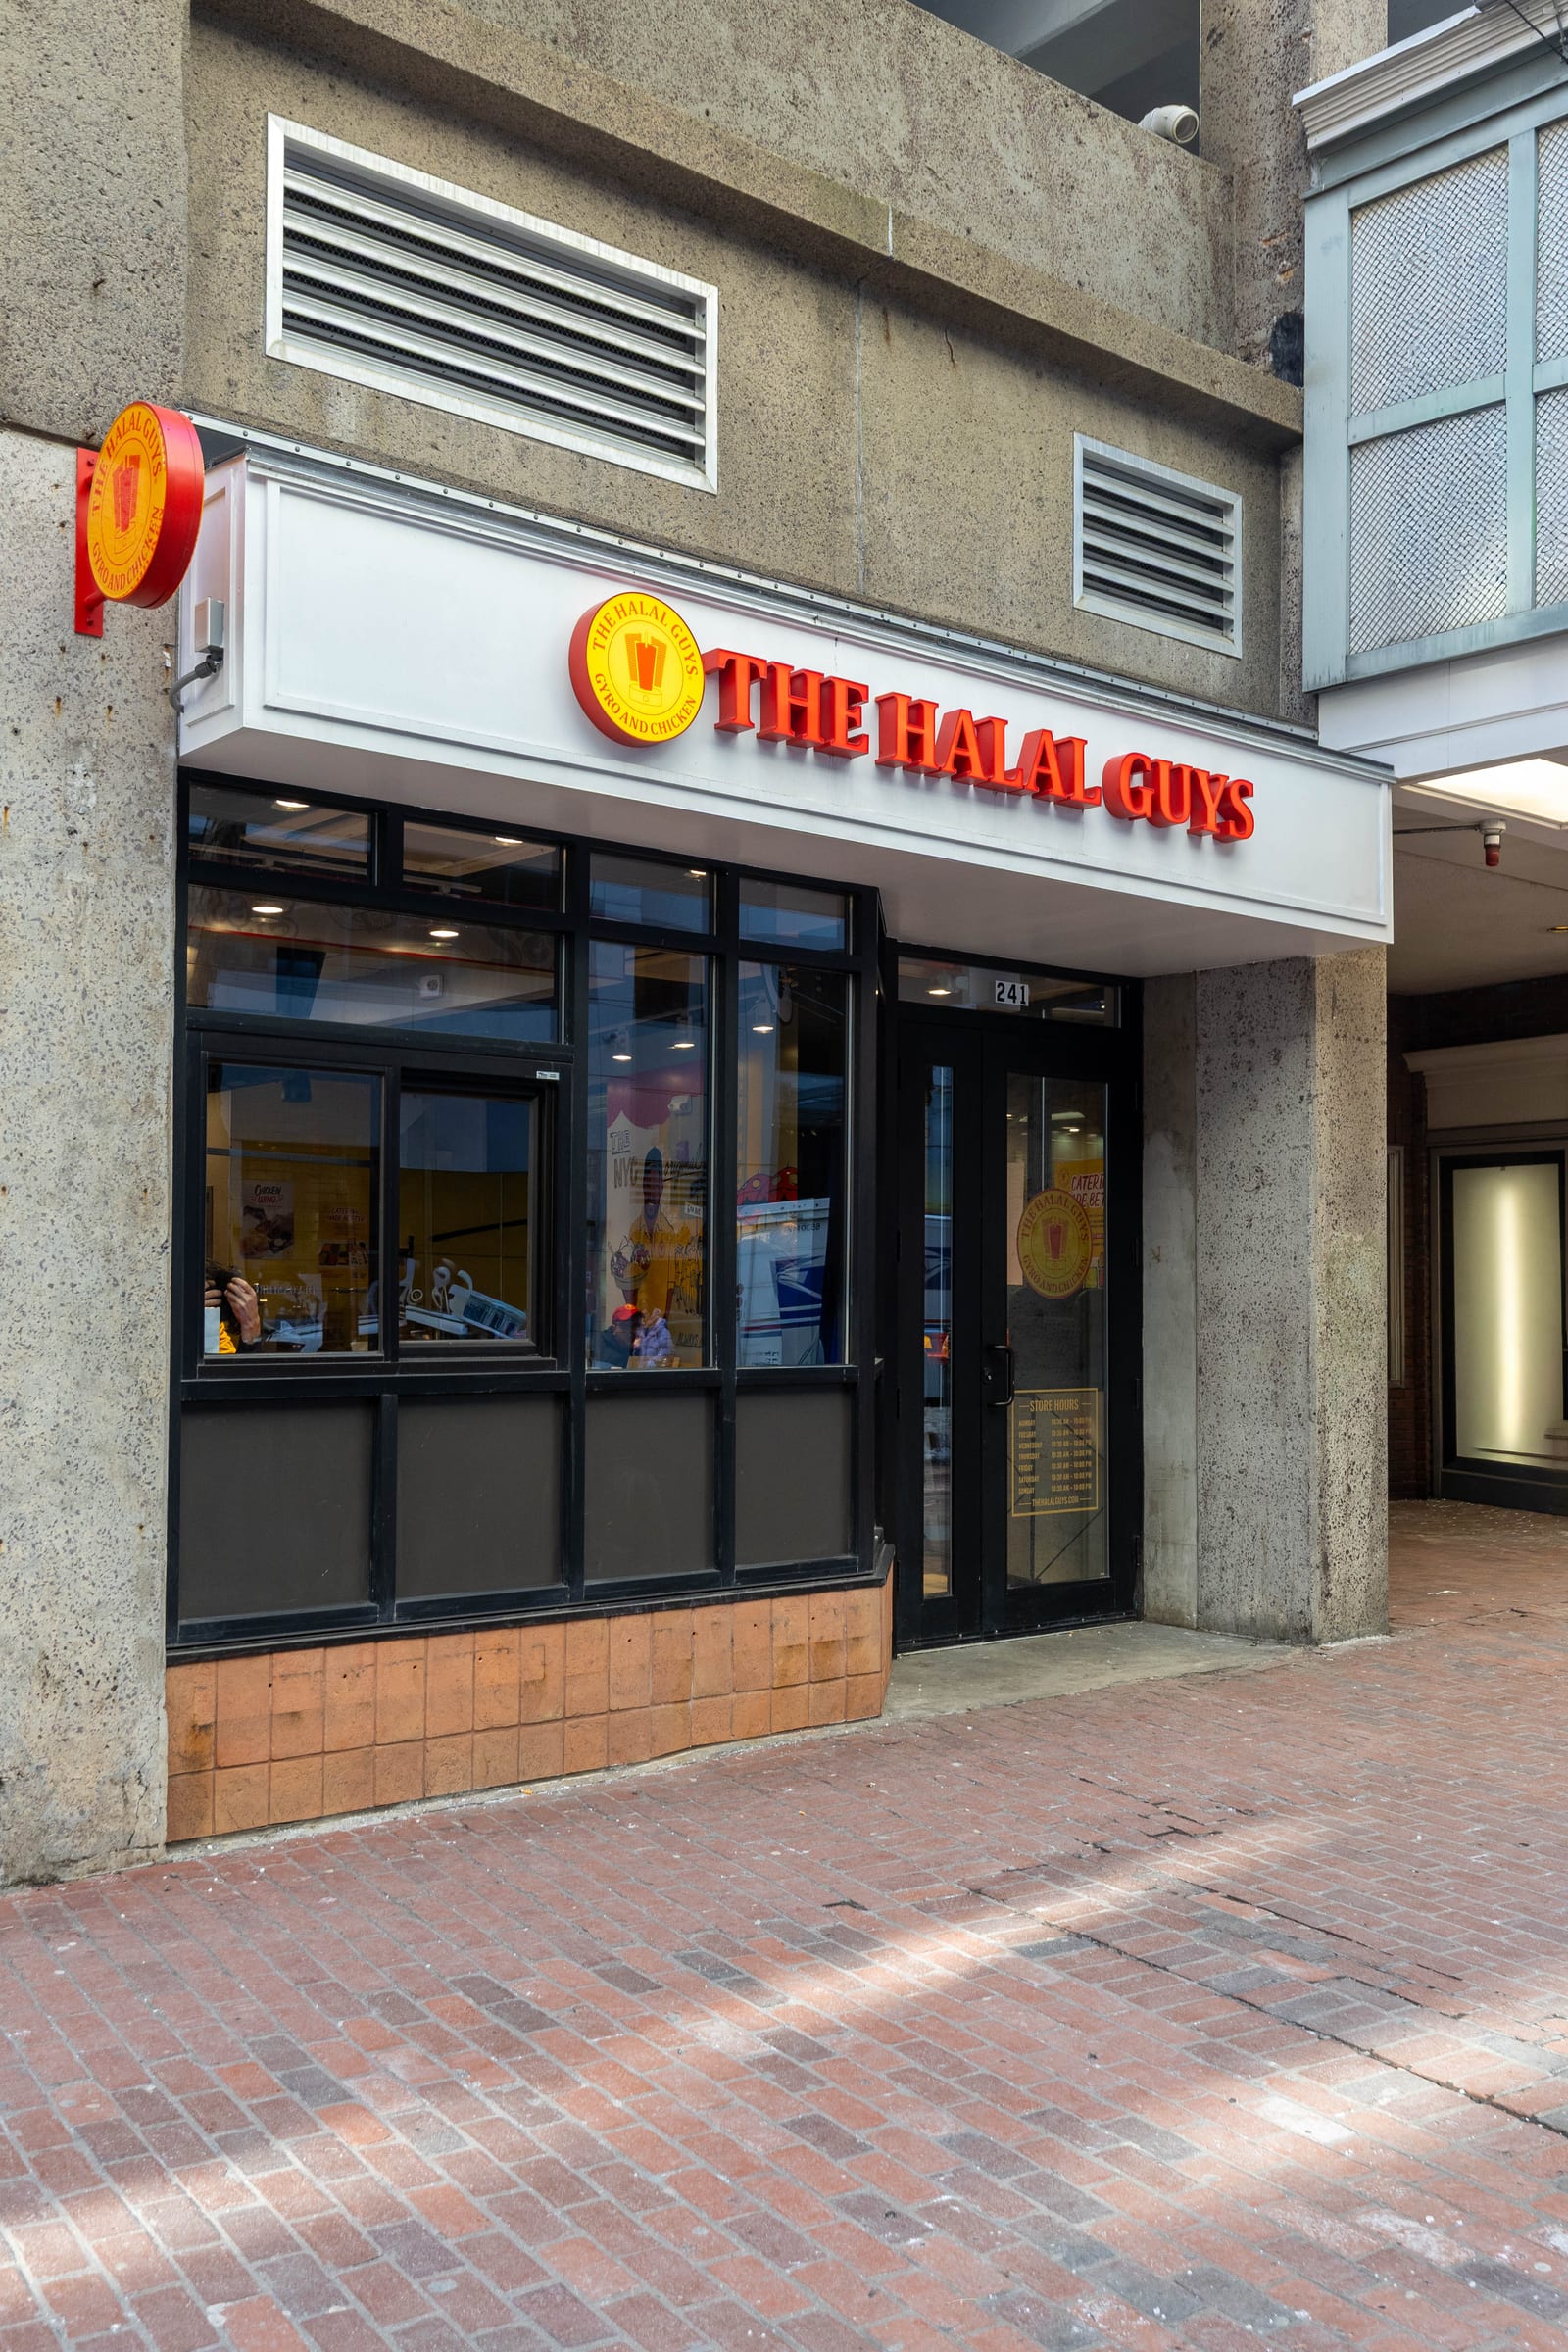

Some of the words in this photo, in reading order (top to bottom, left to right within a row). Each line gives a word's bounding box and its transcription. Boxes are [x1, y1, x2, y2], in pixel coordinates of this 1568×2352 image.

[92, 460, 109, 517] THE
[105, 411, 142, 459] HALAL
[143, 418, 164, 477] GUYS
[93, 542, 109, 583] GYRO
[108, 572, 126, 591] AND
[125, 506, 164, 585] CHICKEN
[593, 612, 616, 651] THE
[613, 600, 668, 627] HALAL
[671, 624, 699, 676] GUYS
[595, 673, 621, 714] GYRO
[619, 711, 649, 734] AND
[650, 695, 697, 735] CHICKEN
[702, 648, 869, 759] THE
[875, 692, 1102, 809] HALAL
[1102, 753, 1254, 843] GUYS
[997, 982, 1026, 1004] 241
[1072, 1173, 1104, 1191] CATERI
[1021, 1208, 1038, 1240] THE
[1035, 1194, 1069, 1211] HALAL
[1069, 1202, 1090, 1242] GUYS
[1022, 1254, 1040, 1285] GYRO
[1039, 1279, 1057, 1294] AND
[1056, 1255, 1090, 1293] CHICKEN
[1029, 1399, 1053, 1412] STORE
[1054, 1398, 1079, 1412] HOURS
